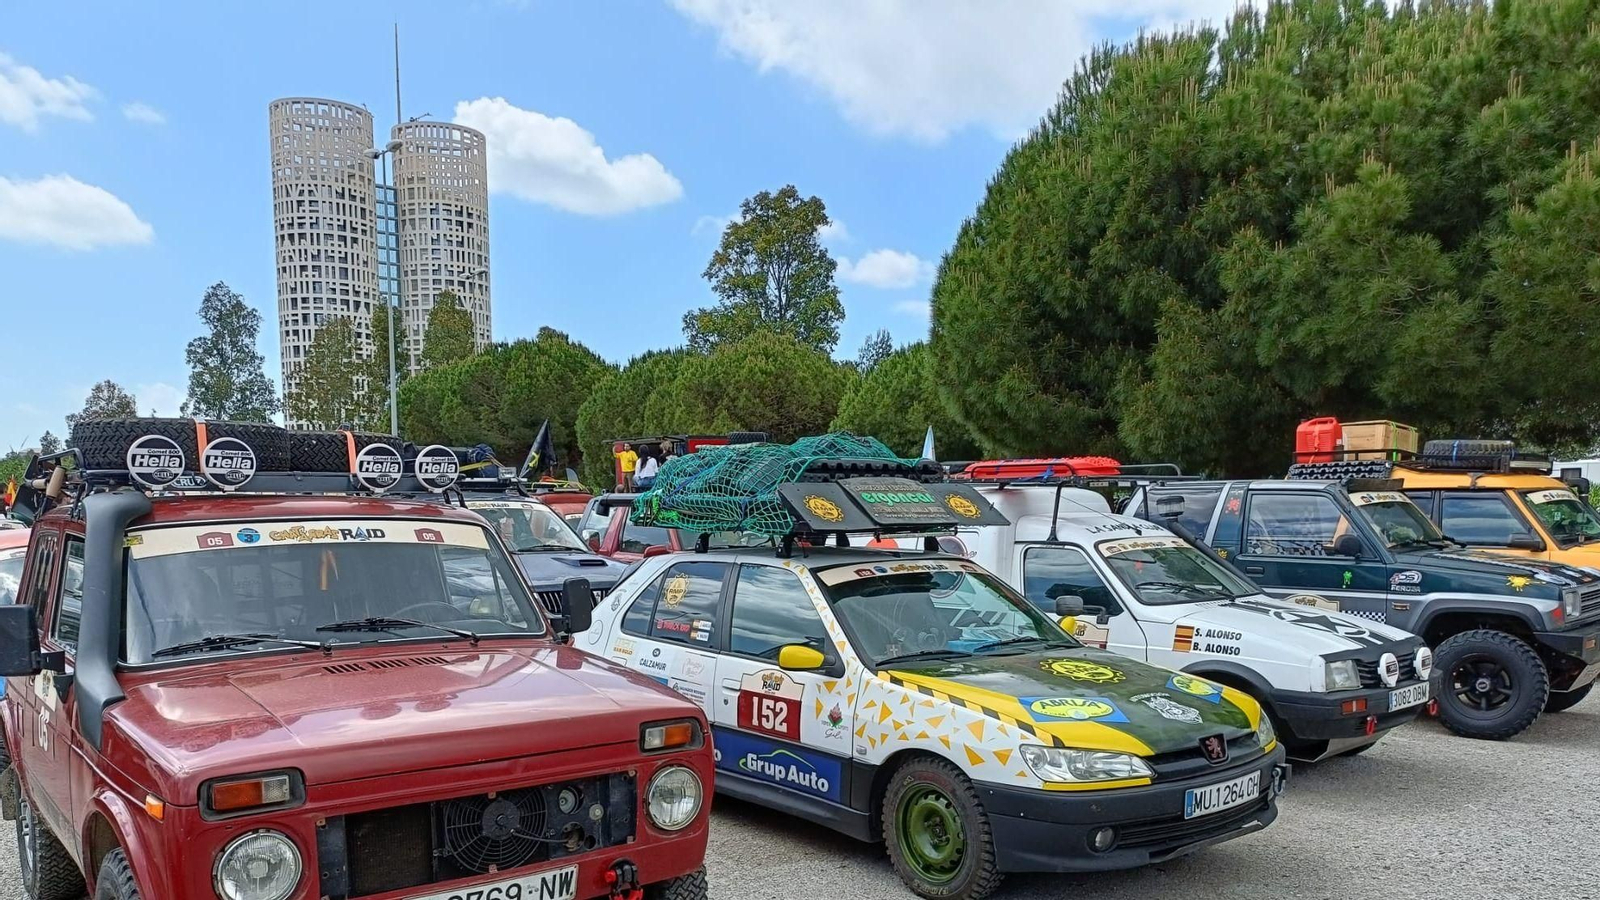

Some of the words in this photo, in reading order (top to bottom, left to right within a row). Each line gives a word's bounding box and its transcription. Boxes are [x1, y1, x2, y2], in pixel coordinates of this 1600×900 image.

[134, 454, 180, 467] Hella
[208, 456, 251, 468] Hella
[361, 461, 399, 473] Hella
[421, 462, 456, 473] Hella
[244, 533, 254, 543] 3
[339, 527, 386, 541] RAID
[422, 532, 435, 541] 05
[207, 537, 223, 546] 05
[1194, 627, 1202, 637] S.
[1205, 631, 1242, 641] ALONSO
[1192, 642, 1201, 651] B.
[1204, 643, 1241, 656] ALONSO
[639, 658, 667, 671] CALZAMUR
[761, 681, 781, 691] RAID
[1039, 699, 1102, 710] ABRISA
[1393, 689, 1412, 708] 3082
[752, 696, 788, 733] 152
[1246, 774, 1260, 797] CH
[540, 870, 575, 900] NW
